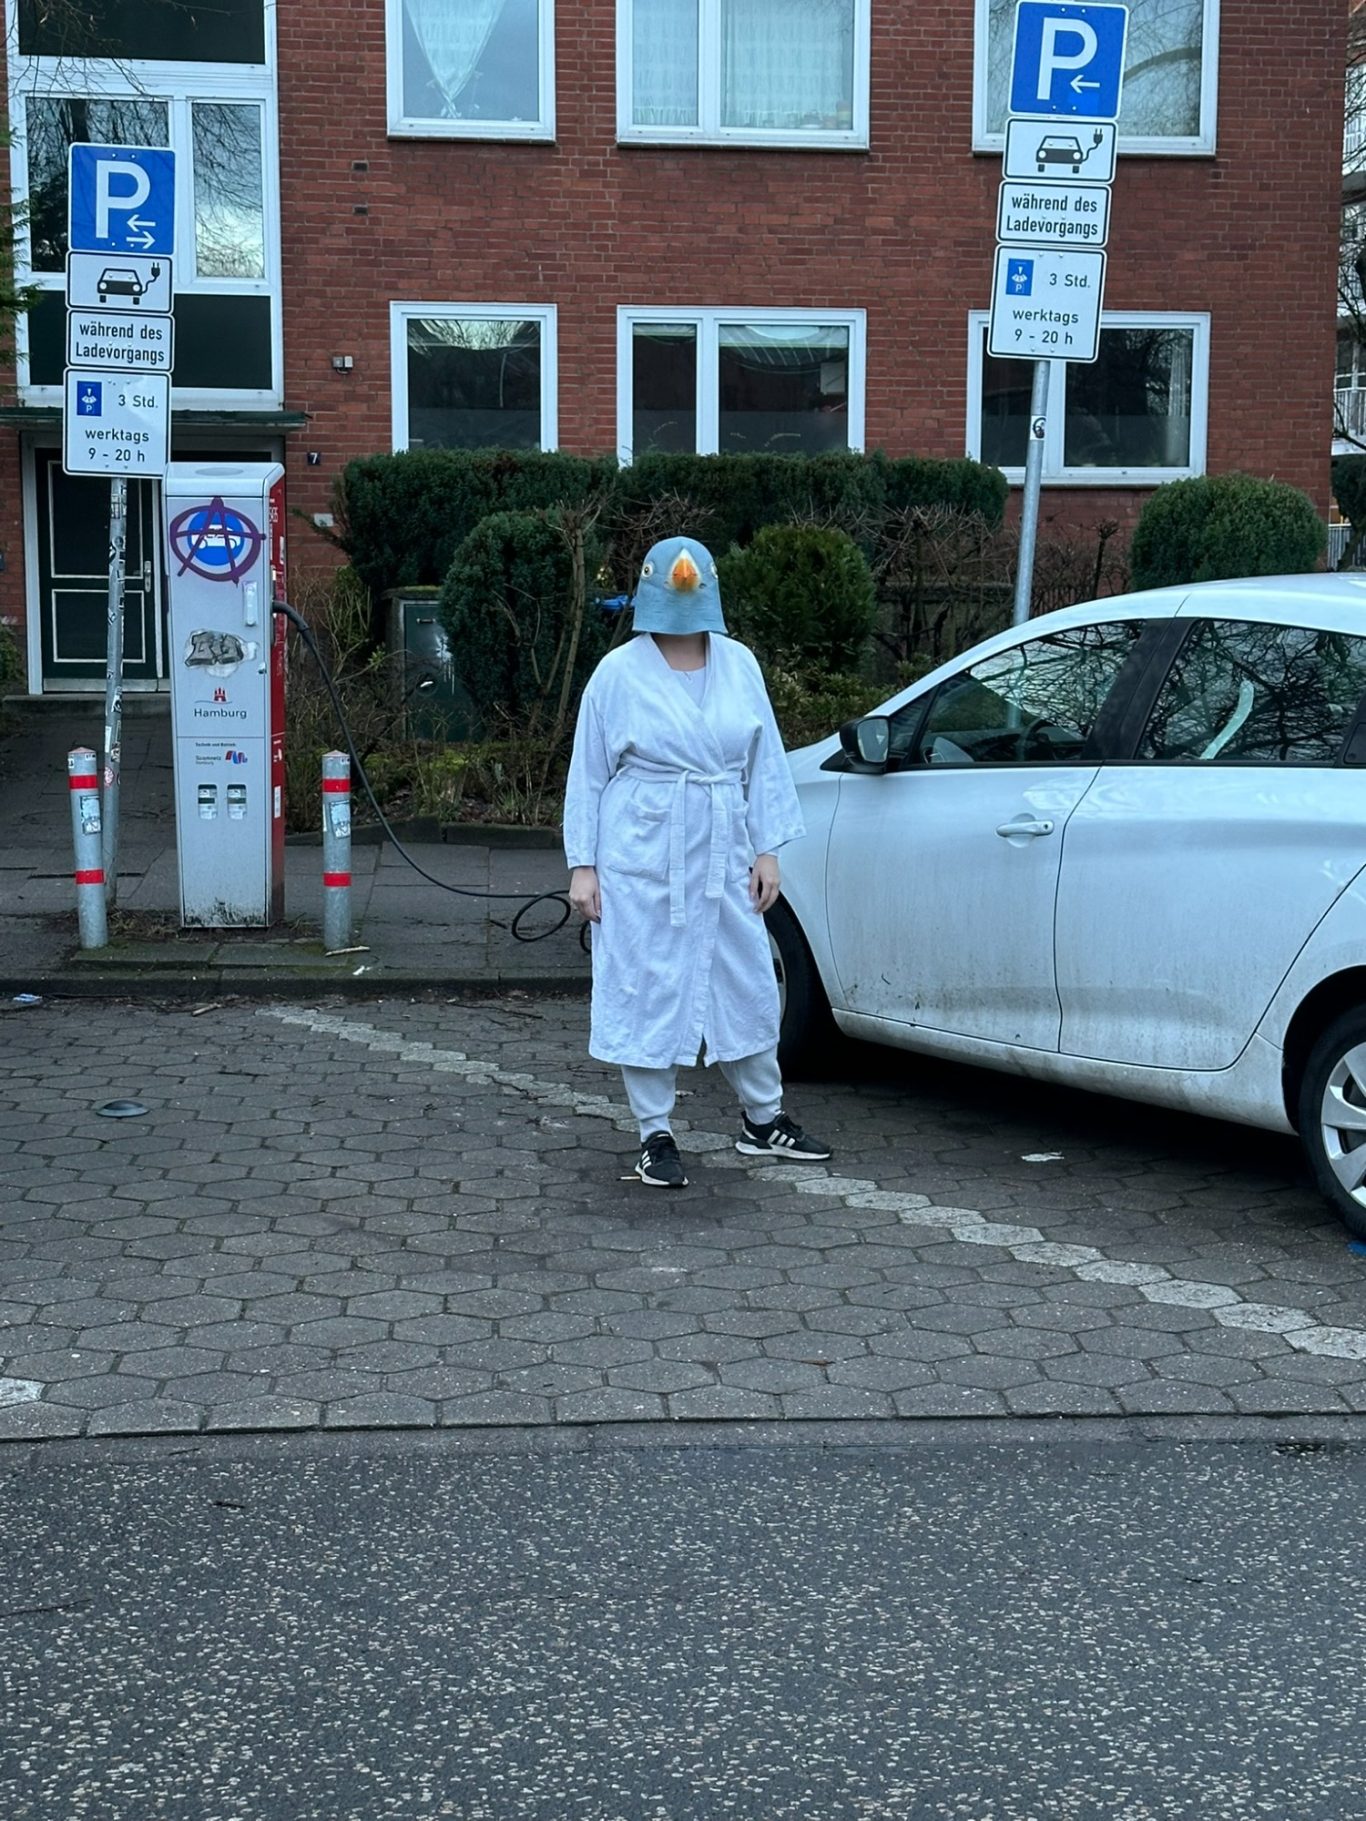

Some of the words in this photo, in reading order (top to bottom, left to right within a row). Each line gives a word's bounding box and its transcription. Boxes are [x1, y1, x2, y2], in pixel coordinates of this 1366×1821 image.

[1037, 17, 1098, 101] P
[95, 160, 150, 239] P
[1011, 192, 1068, 212] während
[1073, 196, 1098, 213] des
[1006, 216, 1099, 238] Ladevorgangs
[1049, 273, 1057, 286] 3
[1064, 273, 1091, 288] Std.
[1012, 308, 1079, 326] werktags
[79, 320, 134, 340] während
[140, 323, 163, 341] des
[1014, 328, 1022, 341] 9
[1041, 330, 1059, 344] 20
[1064, 331, 1073, 345] h
[75, 341, 165, 365] Ladevorgangs
[118, 394, 126, 407] 3
[132, 394, 159, 409] Std.
[85, 427, 150, 445] werktags
[88, 447, 96, 460] 9
[115, 448, 131, 462] 20
[137, 449, 145, 463] h
[310, 452, 318, 464] 7
[193, 708, 248, 720] Hamburg
